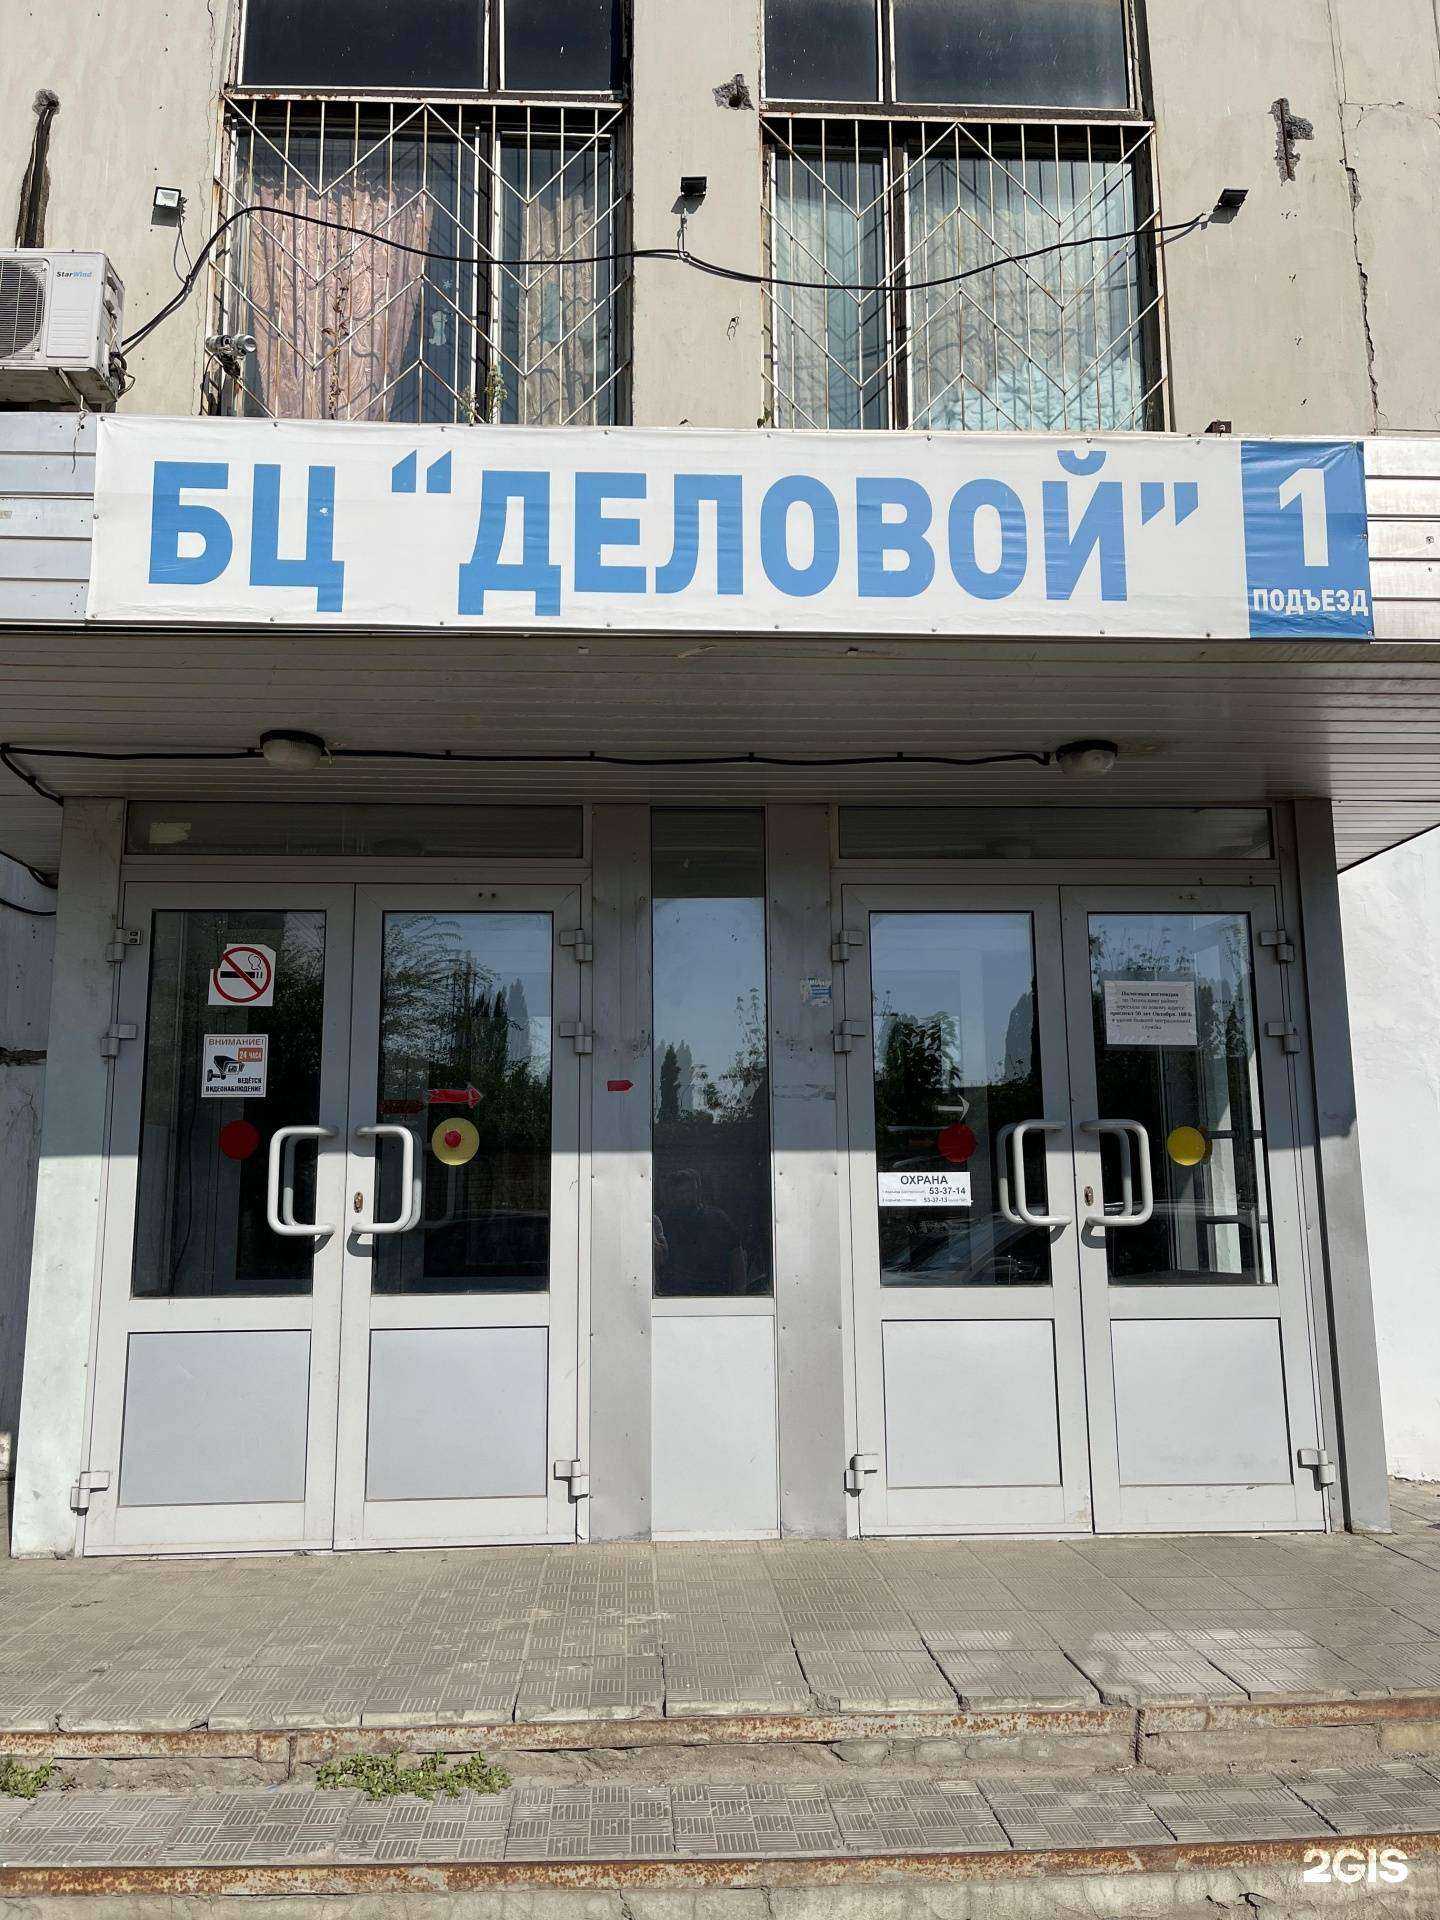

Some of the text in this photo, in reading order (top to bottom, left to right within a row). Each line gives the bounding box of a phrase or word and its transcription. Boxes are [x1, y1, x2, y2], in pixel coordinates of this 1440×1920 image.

[1279, 468, 1329, 566] 1
[148, 460, 345, 613] БЦ
[1252, 588, 1370, 616] ПОДЪЕЗД
[208, 1038, 264, 1046] ВНИМАНИЕ!
[900, 1175, 949, 1185] ОХРАНА
[929, 1186, 966, 1195] 53-37-14
